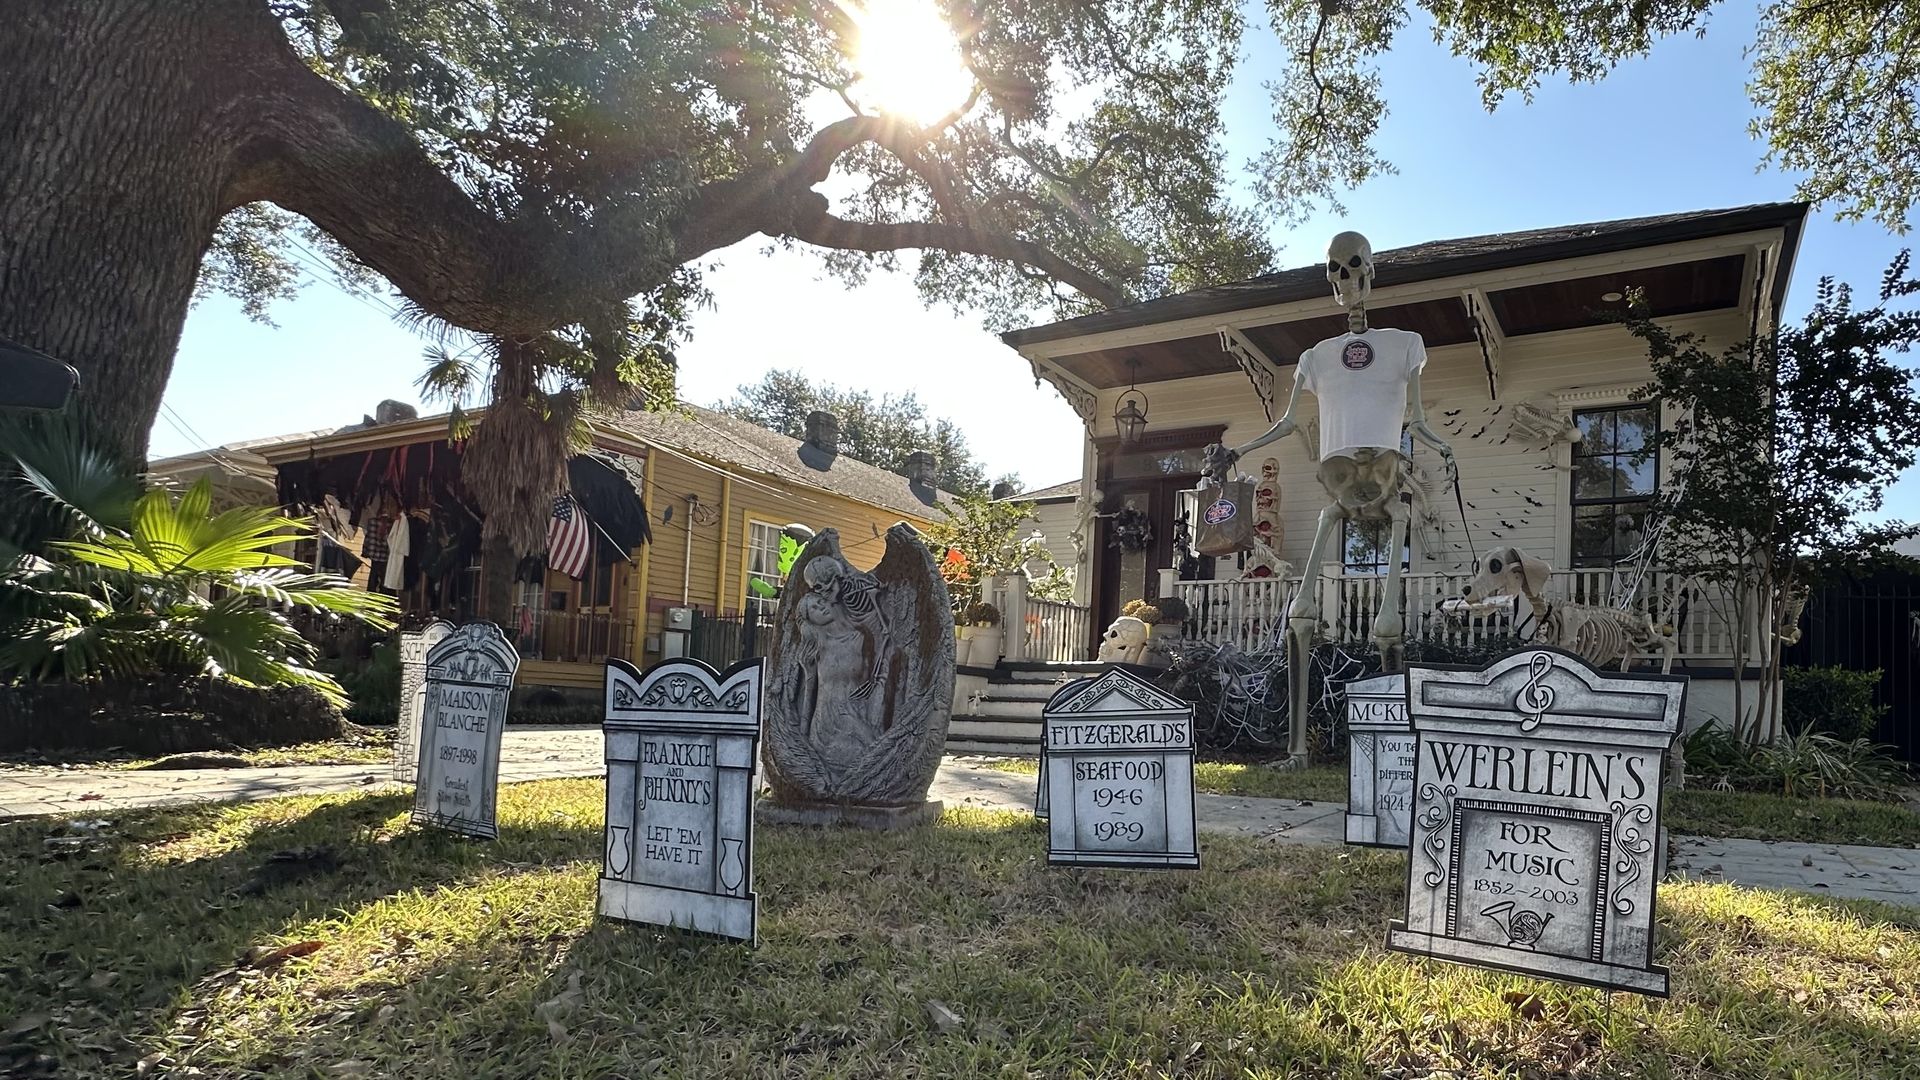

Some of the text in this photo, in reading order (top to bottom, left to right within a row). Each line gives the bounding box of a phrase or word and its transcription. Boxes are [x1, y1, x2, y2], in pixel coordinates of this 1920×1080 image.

[440, 689, 490, 711] MAISON
[438, 712, 487, 733] BLANCHE
[1051, 722, 1186, 748] FITZGERALD'S
[440, 746, 477, 765] 1897-1998
[1379, 740, 1401, 752] YOU
[666, 768, 685, 777] AND
[1076, 761, 1163, 785] SEAFOOD
[1425, 740, 1645, 802] WERLEIN'S
[639, 776, 711, 810] JOHNNY'S
[1093, 787, 1143, 807] 1946
[647, 826, 702, 845] LET 'EM
[1094, 821, 1144, 841] 1989
[1500, 821, 1570, 853] FOR
[645, 844, 702, 865] HAVE IT
[1485, 849, 1580, 885] MUSIC
